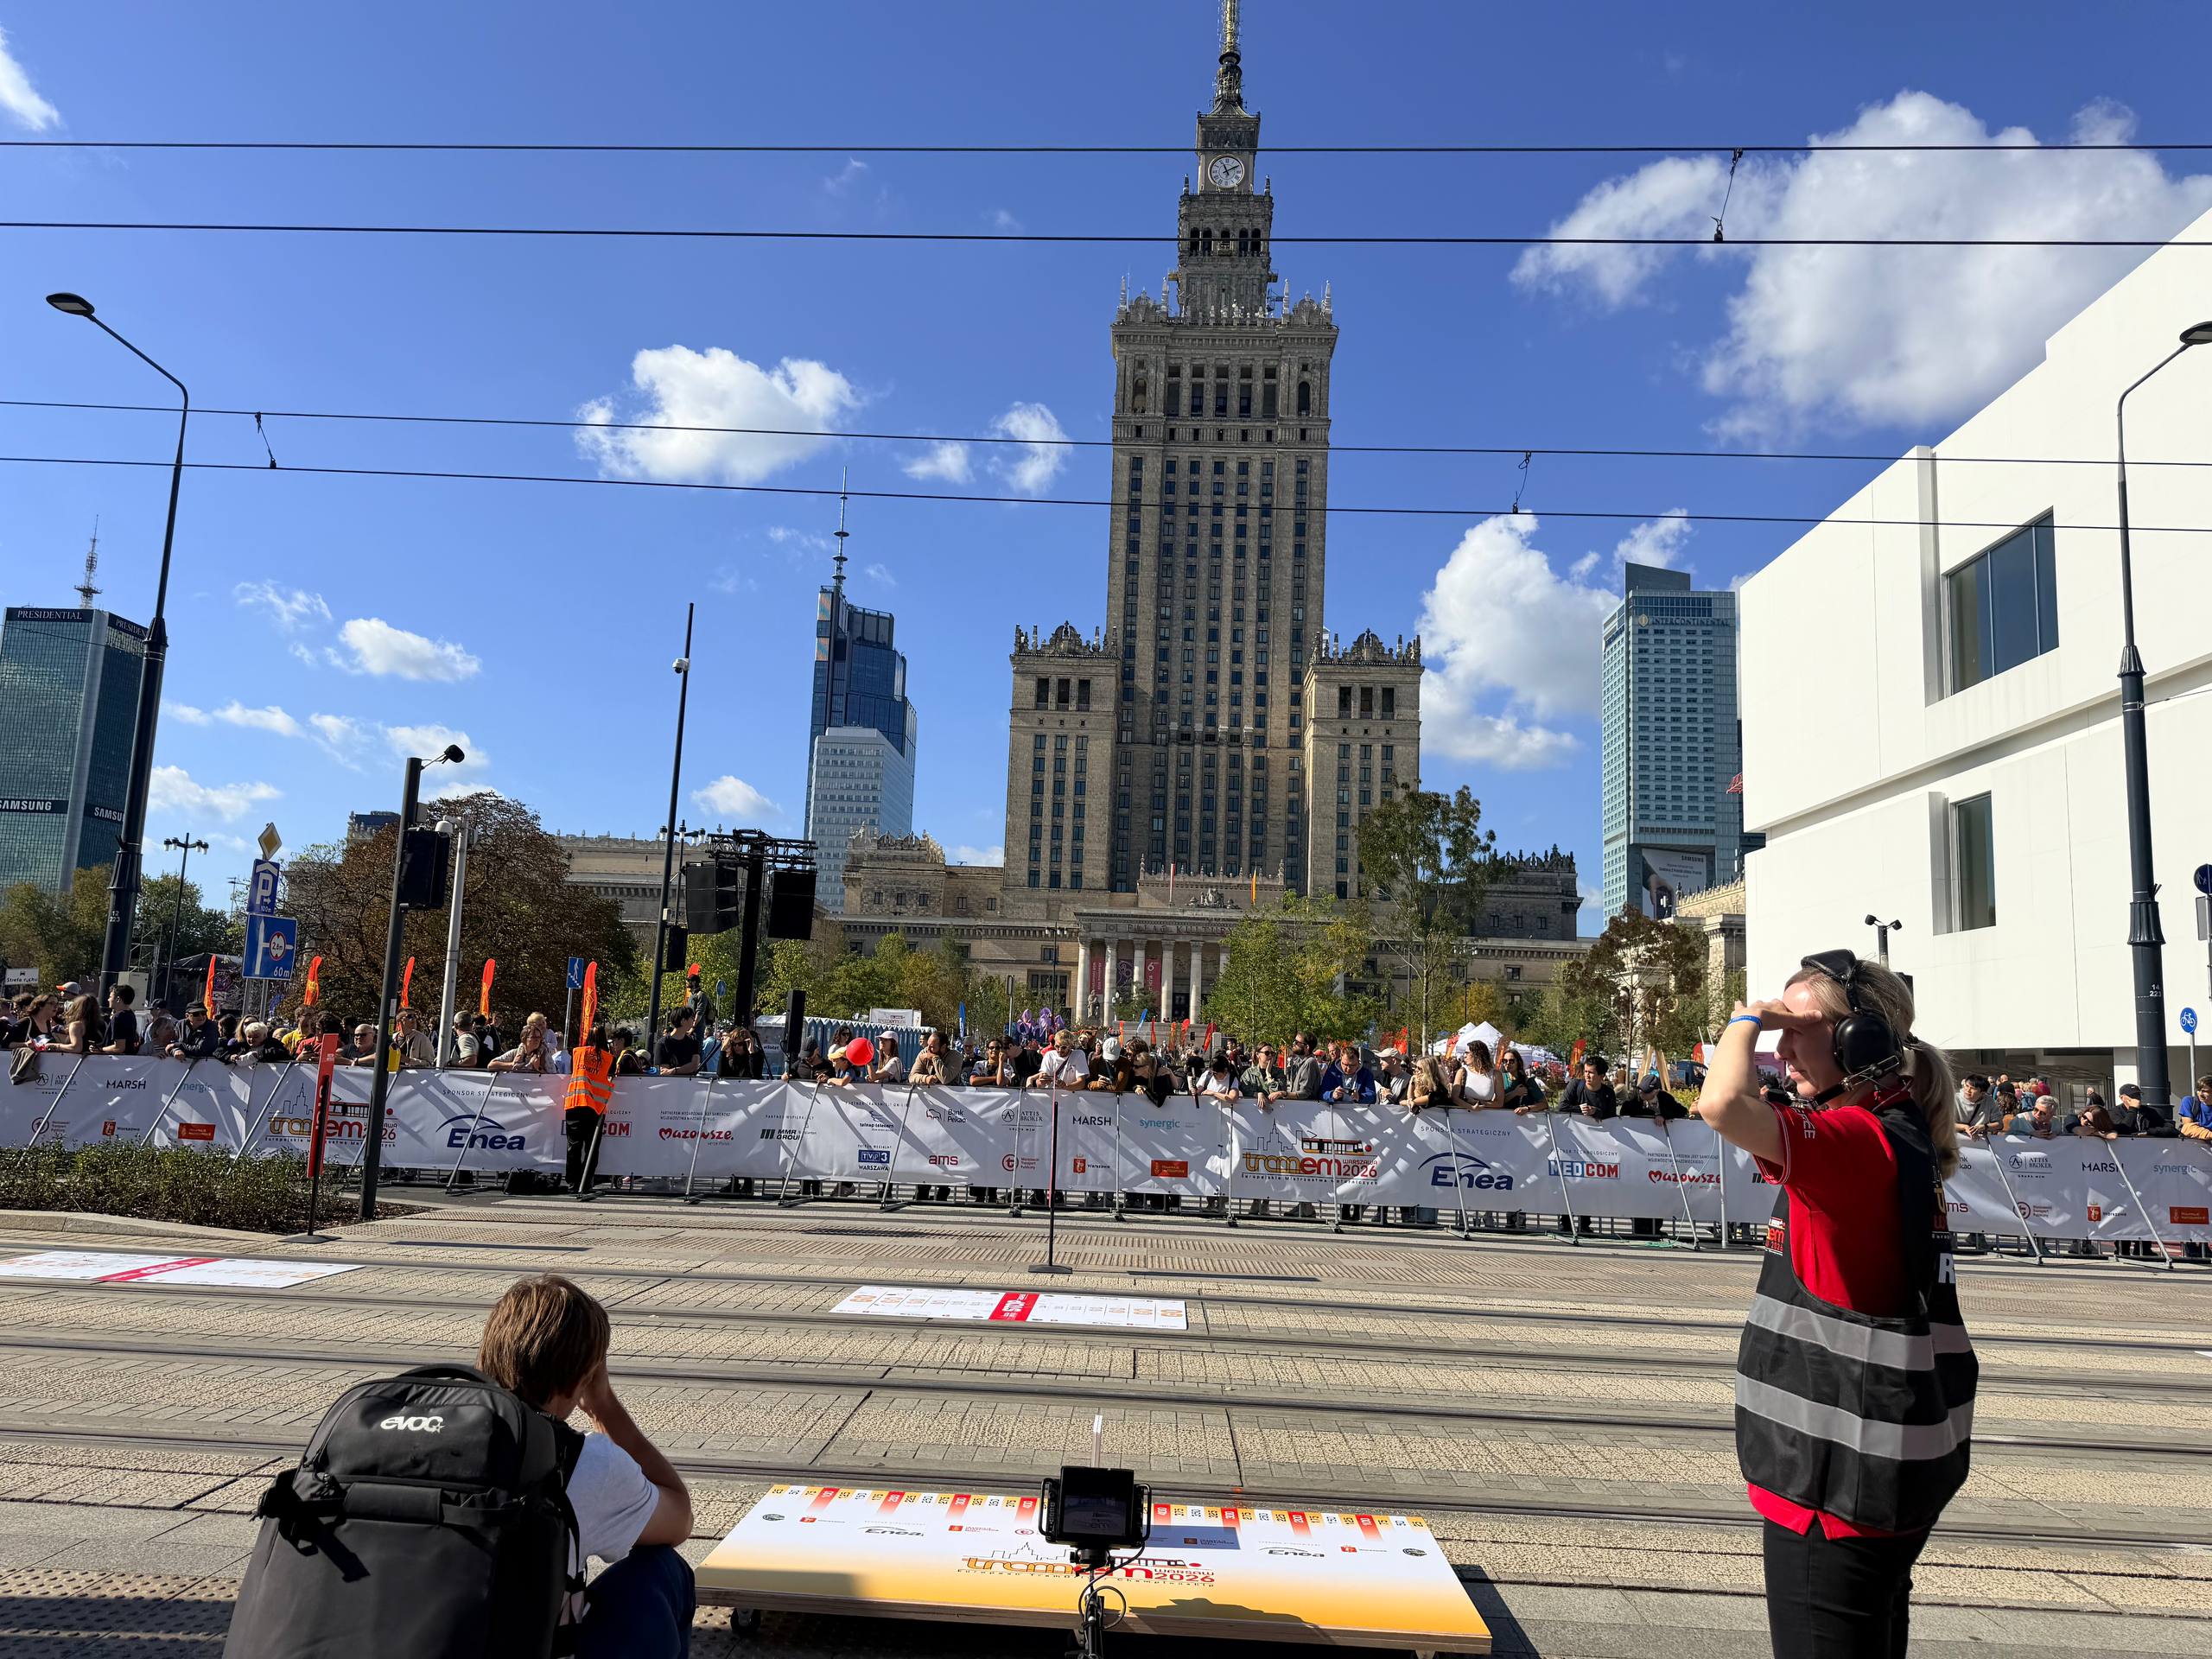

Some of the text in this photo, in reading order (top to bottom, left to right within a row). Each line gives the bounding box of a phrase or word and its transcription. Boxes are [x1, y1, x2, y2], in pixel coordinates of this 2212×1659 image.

[17, 610, 82, 620] PRESIDENTIAL
[94, 807, 124, 822] SAMSU
[256, 872, 273, 905] P
[105, 1079, 146, 1090] MARSH
[1072, 1116, 1111, 1126] MARSH
[1140, 1118, 1180, 1129] synergic
[1458, 1128, 1511, 1137] STRATEGICZNY
[447, 1128, 525, 1150] Enea
[880, 1152, 887, 1162] 3
[928, 1154, 958, 1166] ams
[1343, 1164, 1377, 1178] 2026
[1549, 1160, 1618, 1179] MEDCOM
[2153, 1164, 2197, 1175] synergic
[1431, 1166, 1514, 1191] Enea
[1947, 1202, 1969, 1213] ms
[1154, 1573, 1216, 1583] 2026
